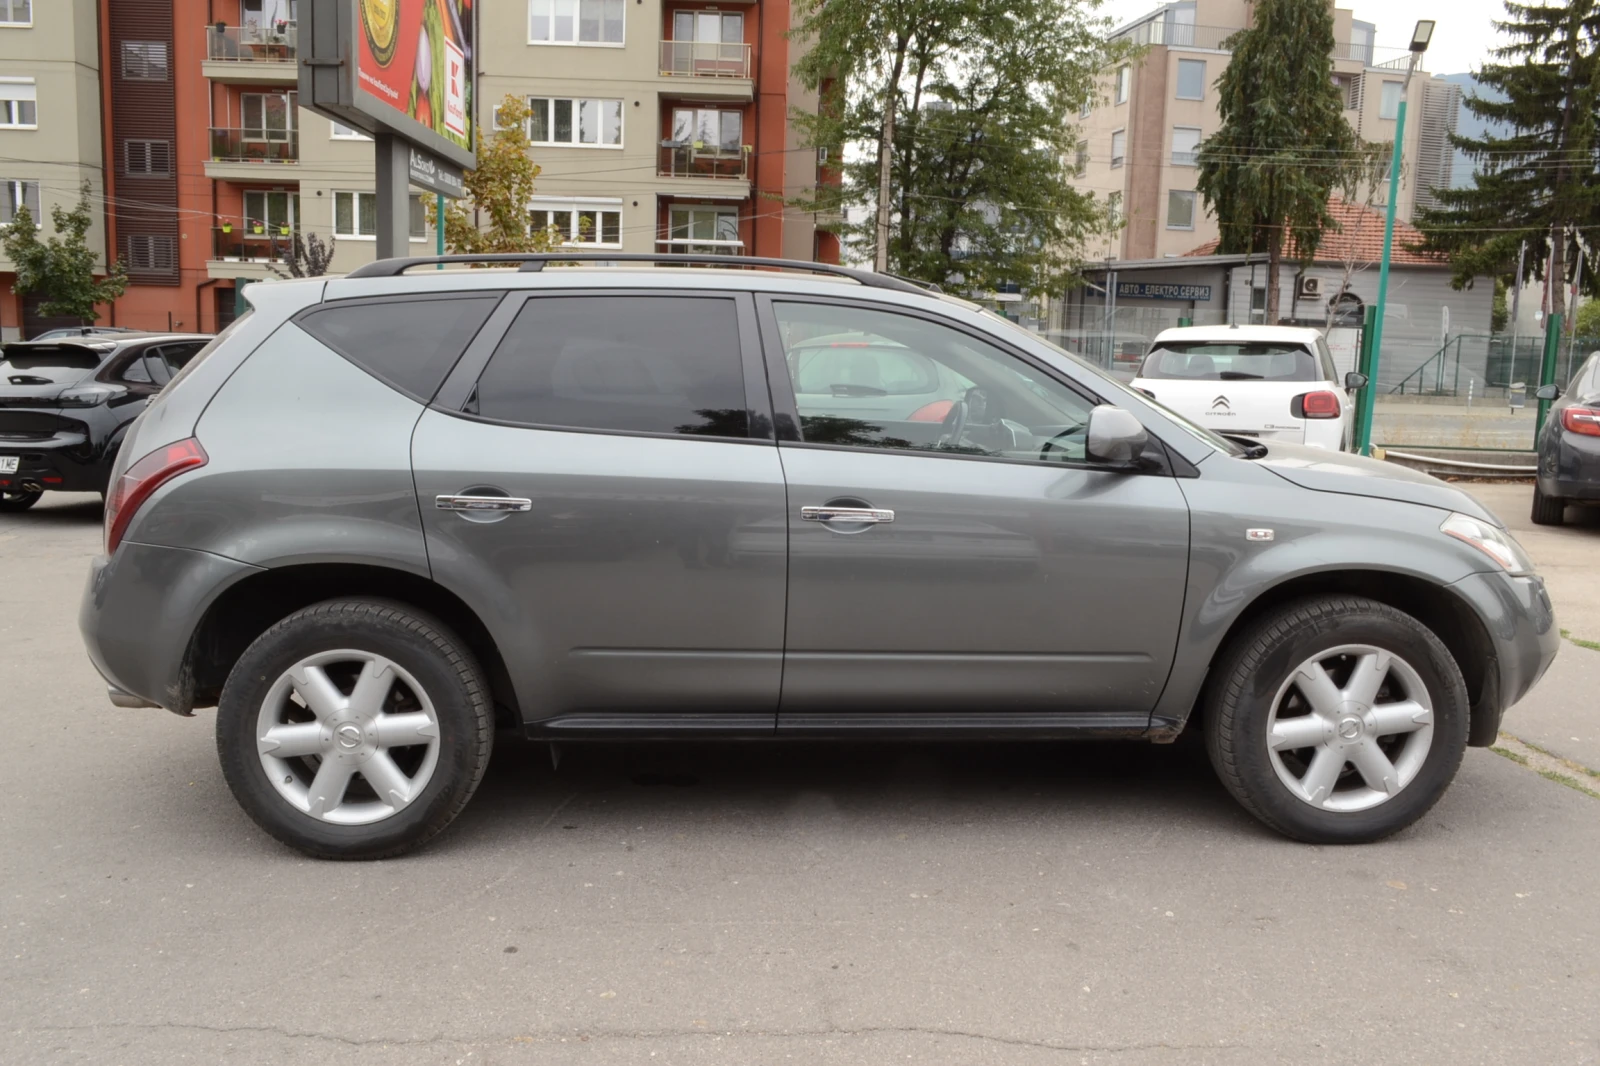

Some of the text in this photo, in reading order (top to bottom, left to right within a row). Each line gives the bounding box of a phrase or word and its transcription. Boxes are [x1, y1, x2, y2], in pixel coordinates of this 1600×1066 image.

[1119, 284, 1140, 294] АВТО
[1145, 285, 1179, 295] ЕЛЕКТРО
[1180, 286, 1210, 297] СЕРВИЗ
